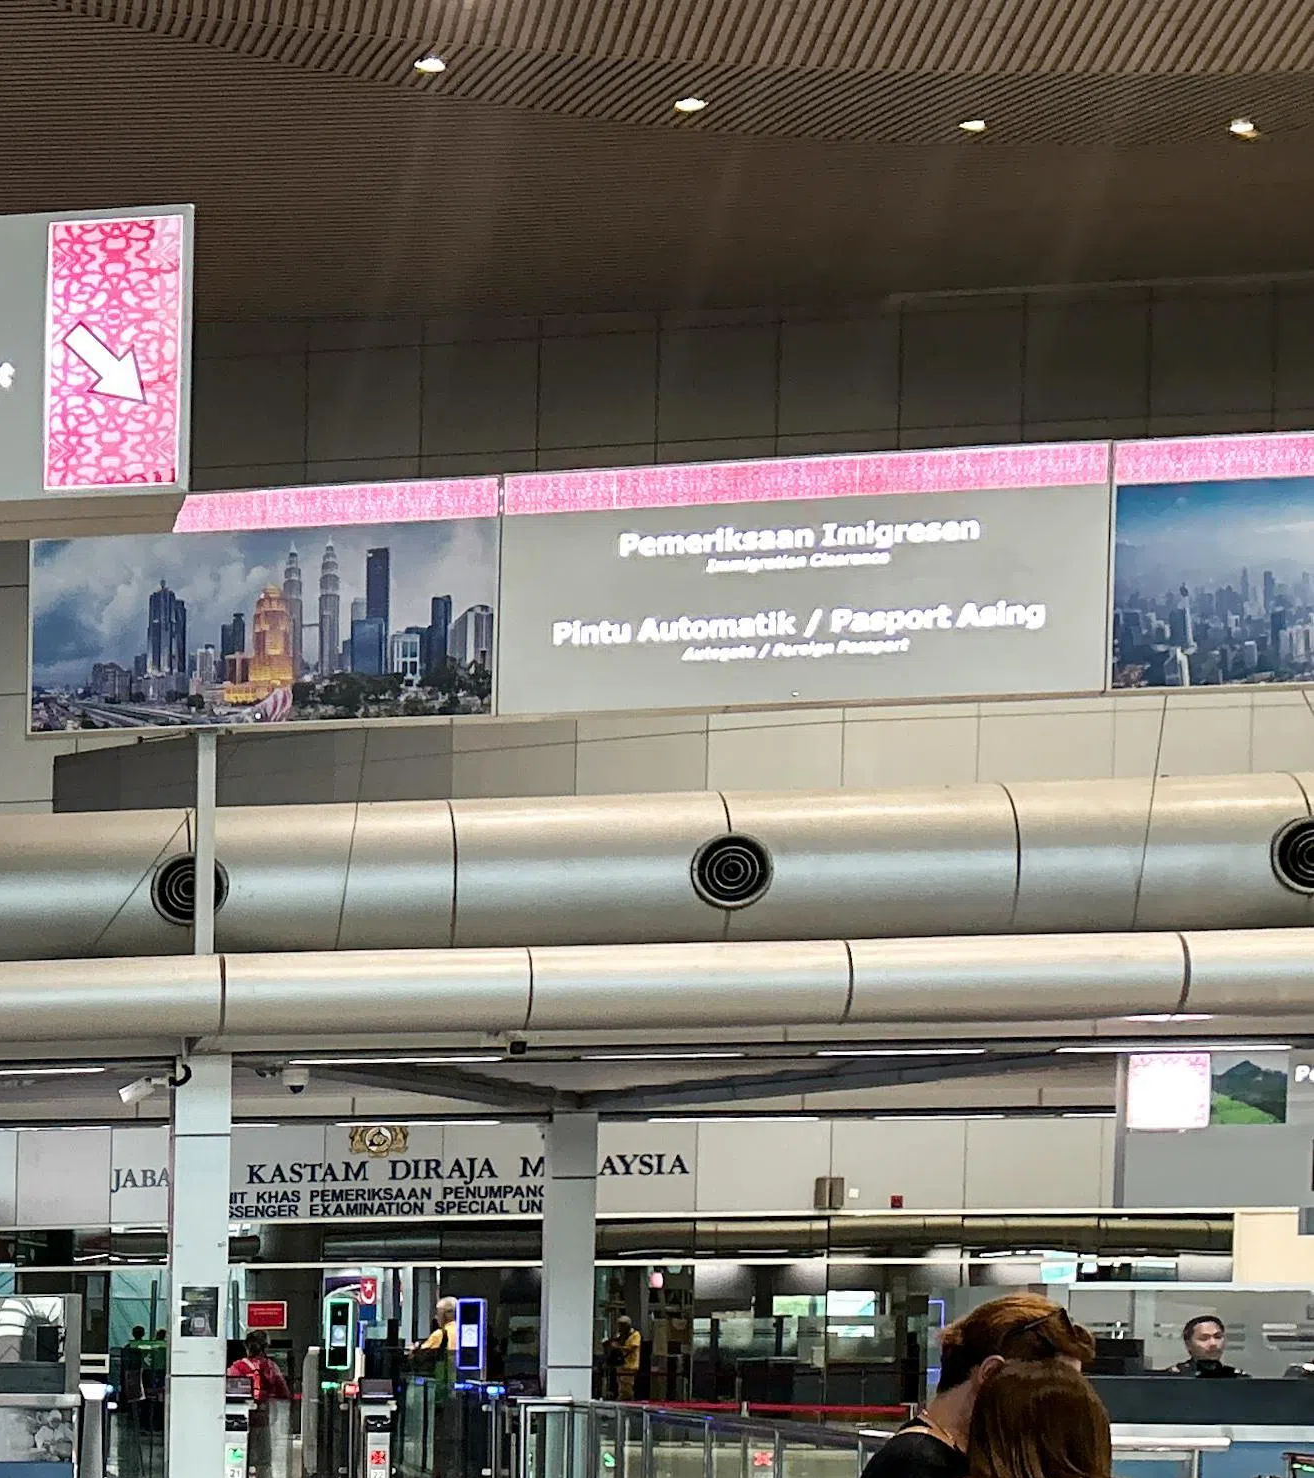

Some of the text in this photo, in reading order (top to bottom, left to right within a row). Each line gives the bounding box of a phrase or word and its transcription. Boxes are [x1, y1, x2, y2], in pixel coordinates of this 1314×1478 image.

[619, 517, 980, 559] Pemeriksaan Imigresen
[552, 600, 1046, 647] Pintu Automatik / Pasport Asing
[246, 1160, 369, 1186] KASTAM
[388, 1157, 499, 1185] DIRAJA
[256, 1190, 301, 1204] KHAS
[309, 1186, 432, 1202] PEMERIKSAAN
[309, 1199, 542, 1216] EXAMINATION SPECIAL UN
[230, 1469, 240, 1478] 21
